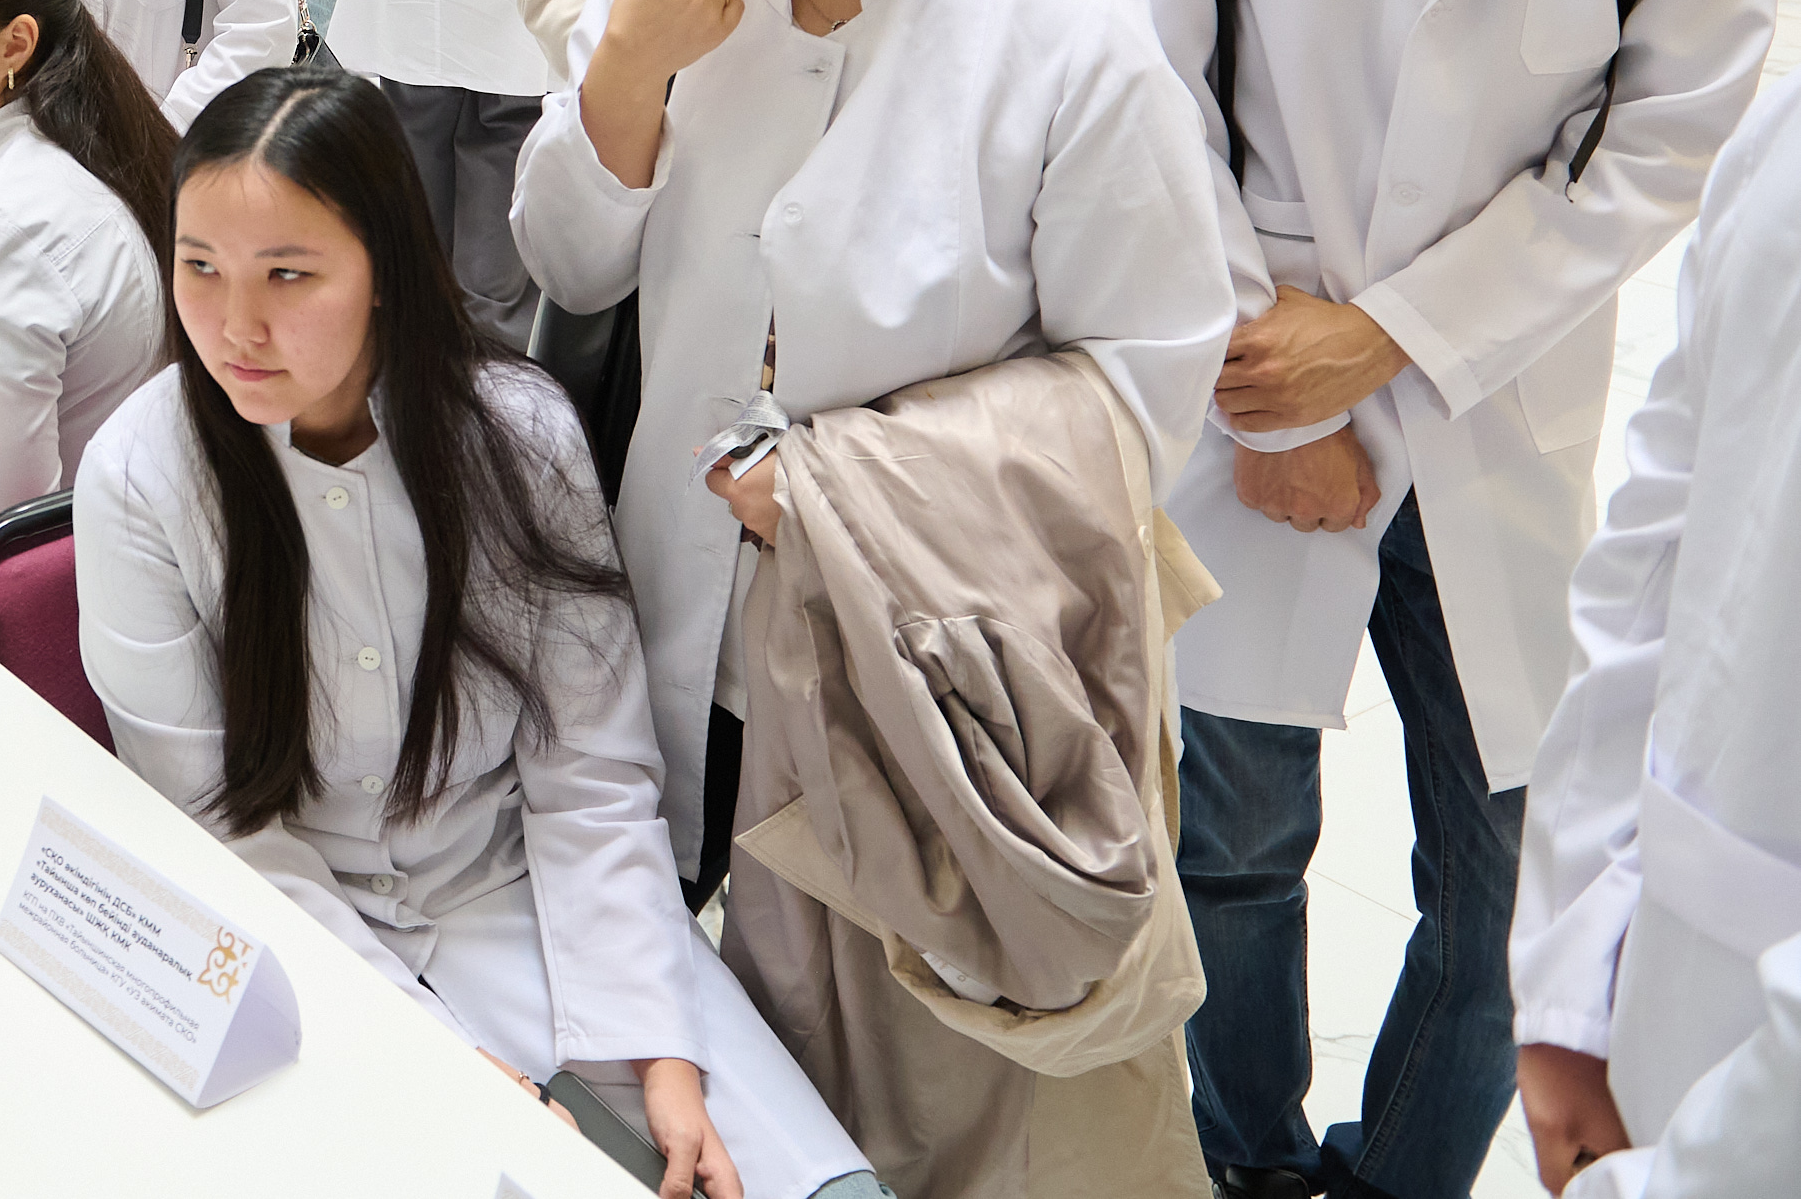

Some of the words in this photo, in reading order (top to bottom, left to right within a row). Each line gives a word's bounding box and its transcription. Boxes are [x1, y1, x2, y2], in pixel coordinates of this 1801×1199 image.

[36, 860, 78, 895] «Тайынша
[80, 892, 96, 907] көп
[38, 903, 47, 914] на
[138, 914, 161, 936] КММ
[110, 930, 131, 951] КМК
